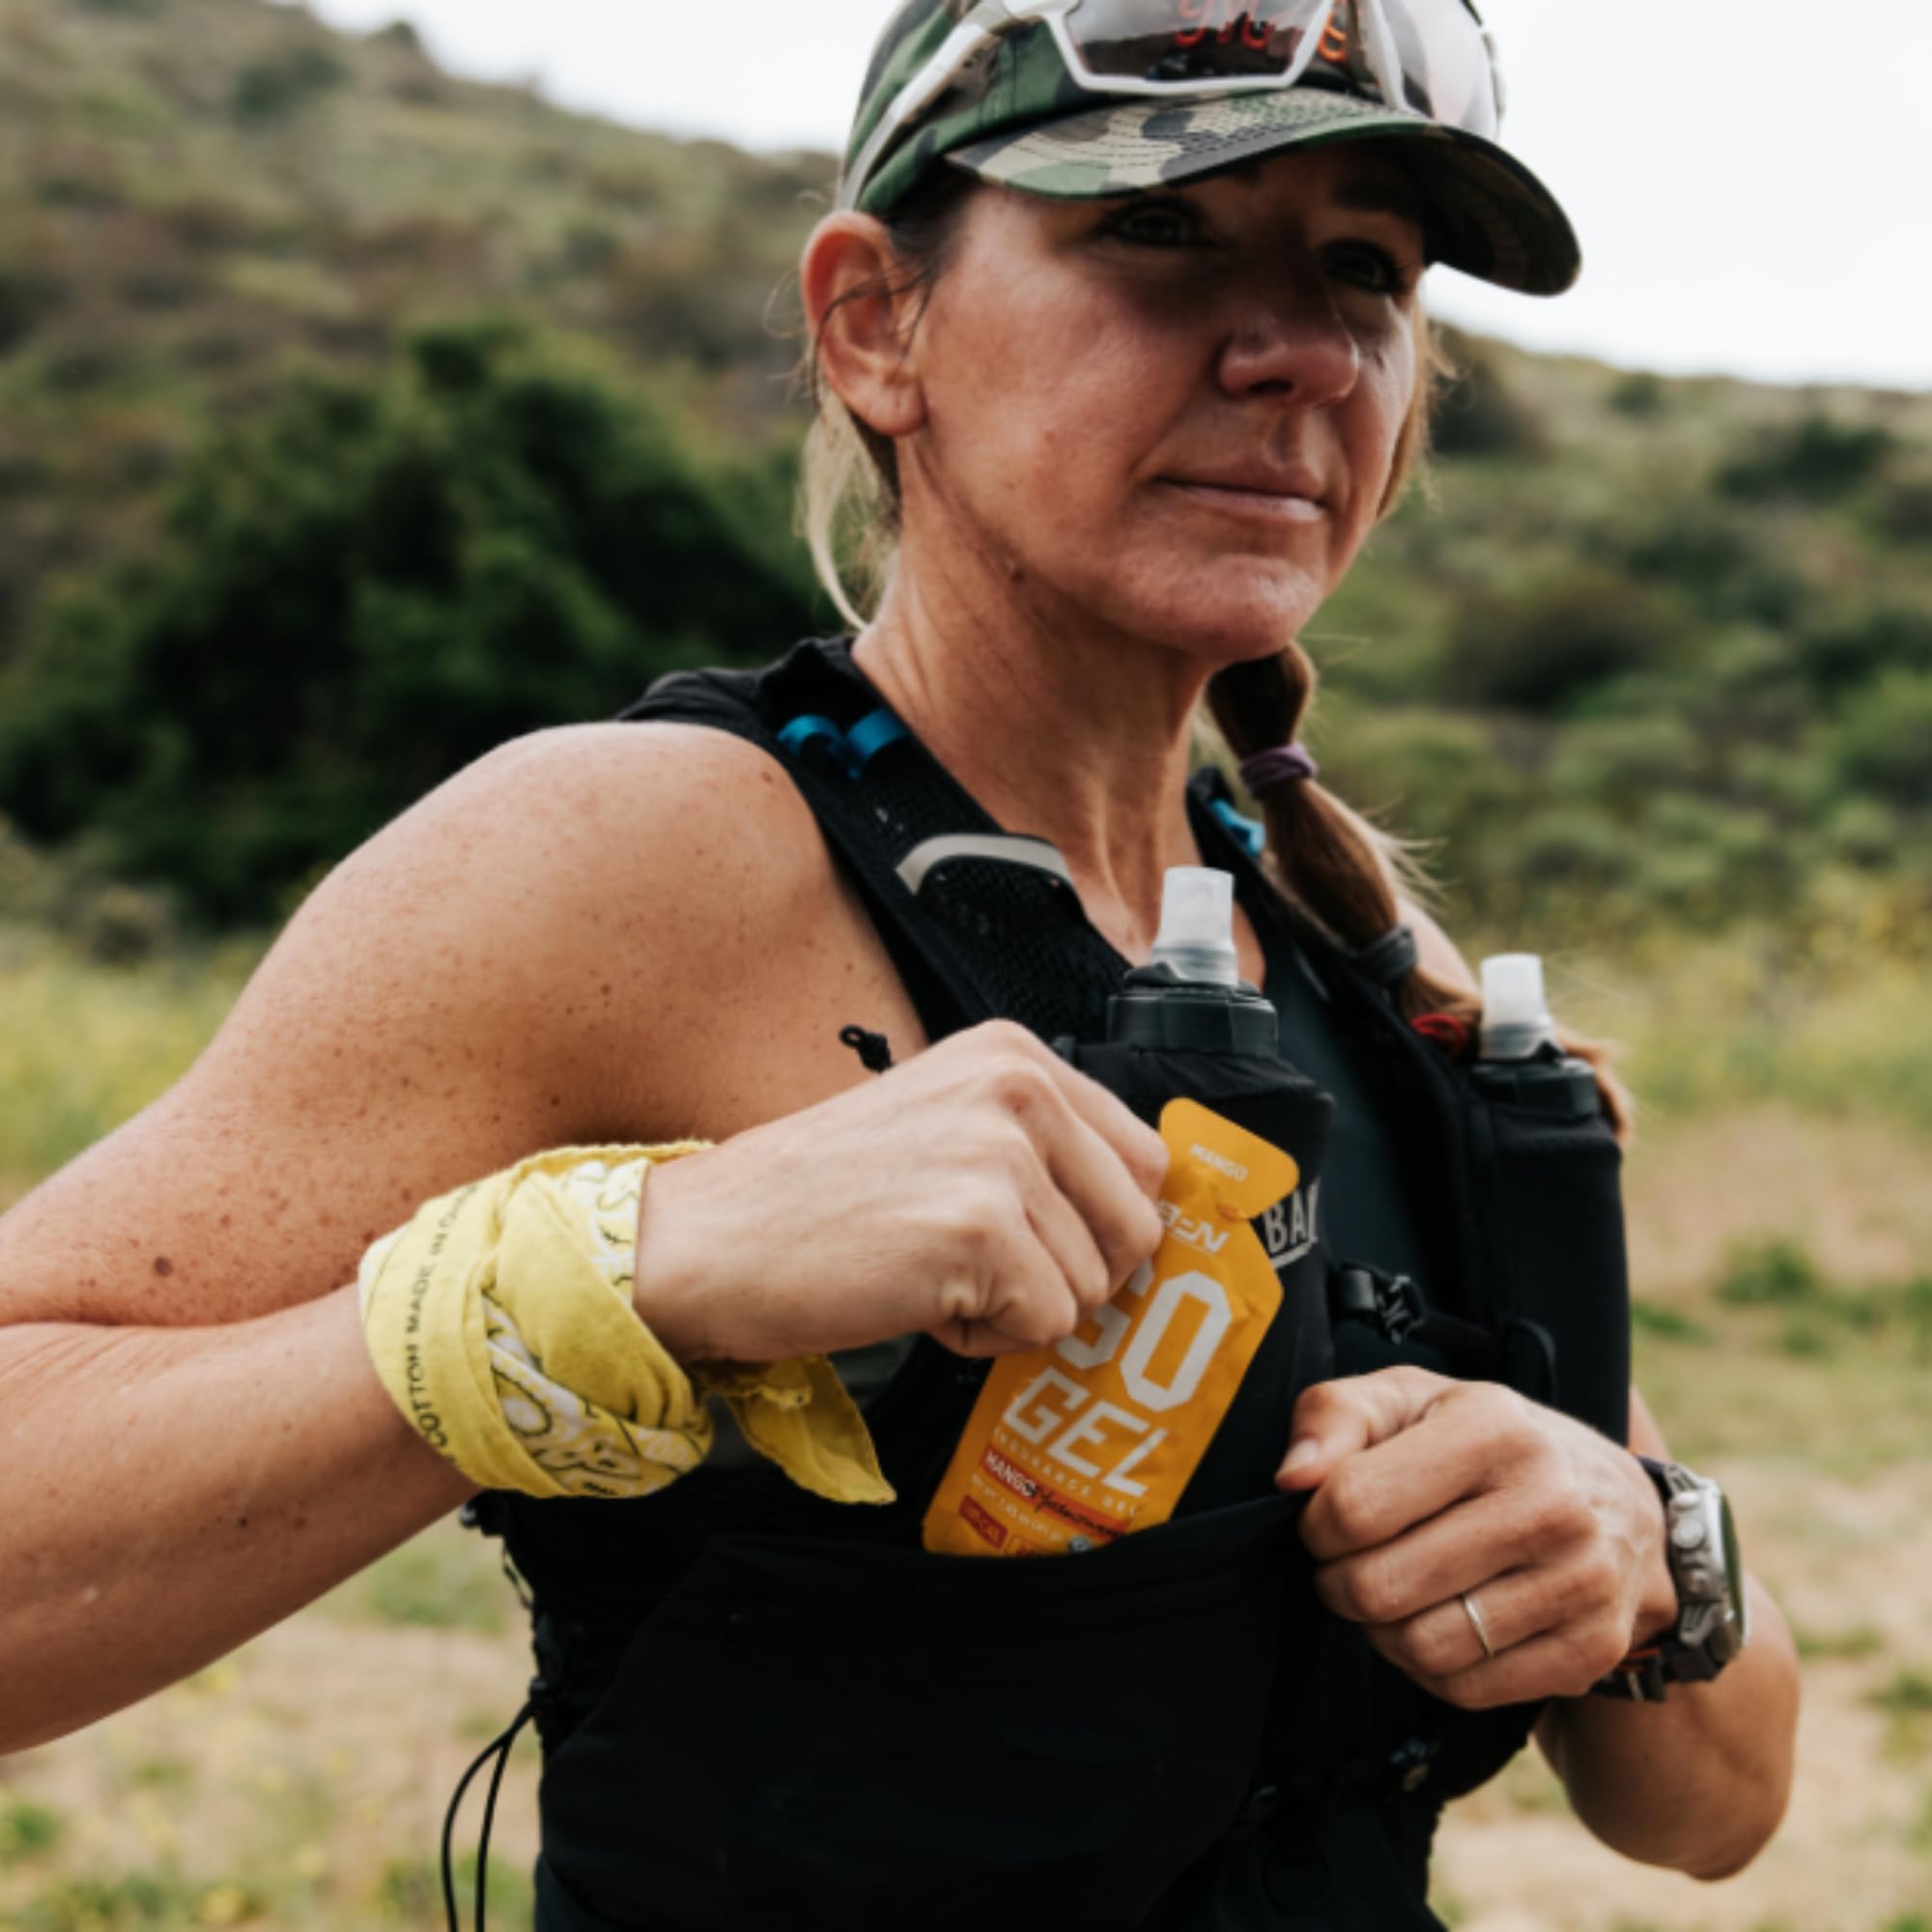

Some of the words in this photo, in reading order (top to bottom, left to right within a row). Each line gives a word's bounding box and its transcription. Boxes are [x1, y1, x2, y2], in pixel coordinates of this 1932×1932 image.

[1190, 1143, 1248, 1183] MANGO
[1002, 1366, 1167, 1497] GEL
[985, 1449, 1037, 1497] MANGO
